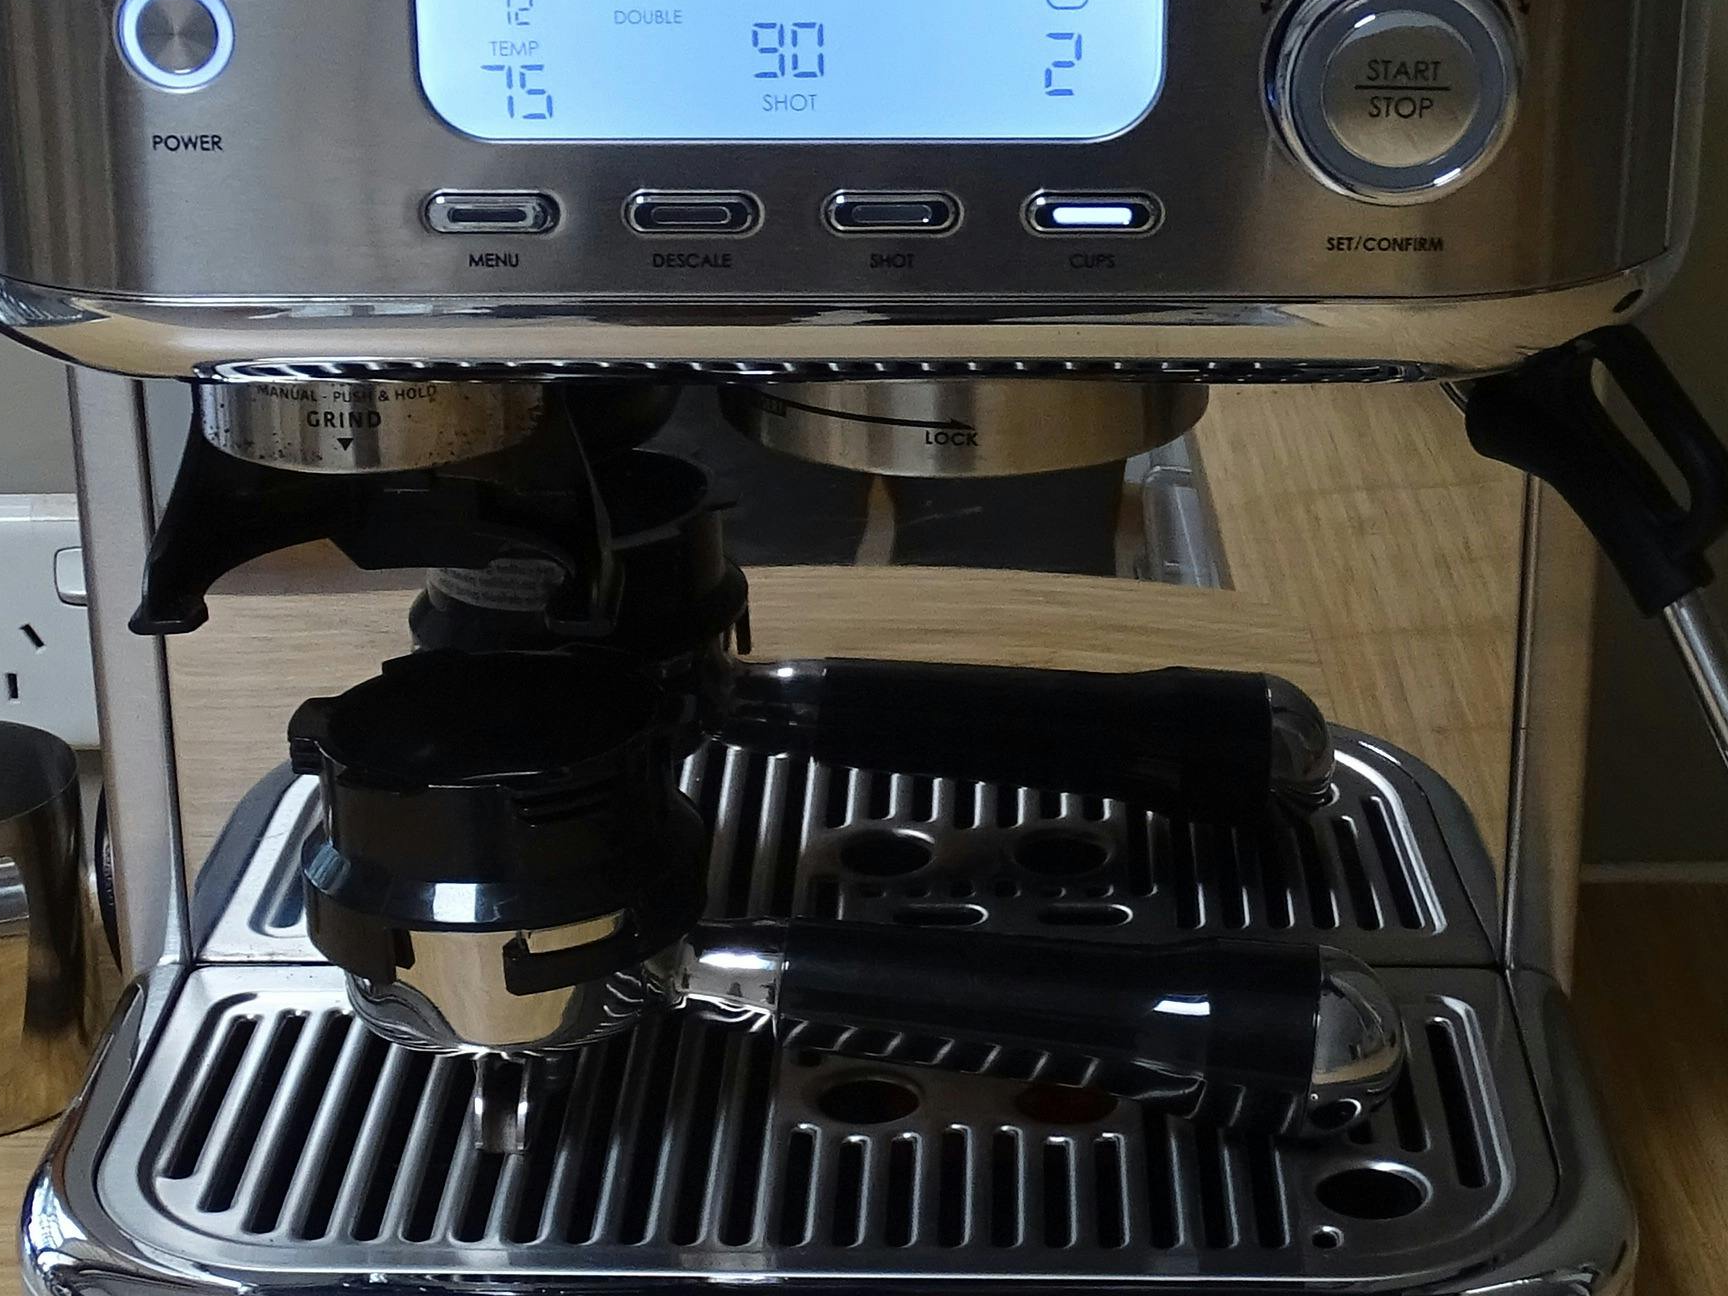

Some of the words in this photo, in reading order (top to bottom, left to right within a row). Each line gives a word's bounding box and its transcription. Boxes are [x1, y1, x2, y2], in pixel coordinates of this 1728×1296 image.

[613, 9, 683, 24] DOUBLE
[489, 40, 539, 56] TEMP
[751, 22, 824, 79] 90
[1045, 32, 1082, 96] 2
[1366, 59, 1442, 81] START
[480, 64, 553, 119] 75
[762, 93, 818, 111] SHOT
[1368, 96, 1434, 119] STOP
[151, 134, 223, 151] POWER
[1325, 236, 1444, 253] SET/CONFIRM
[468, 253, 519, 268] MENU
[652, 253, 733, 268] DESCALE
[869, 253, 915, 268] SHOT
[1069, 253, 1116, 269] CUPS
[256, 384, 318, 402] MANUAL
[333, 390, 373, 403] PUSH
[395, 384, 437, 401] HOLD
[306, 409, 382, 429] GRIND
[924, 430, 979, 447] LOCK
